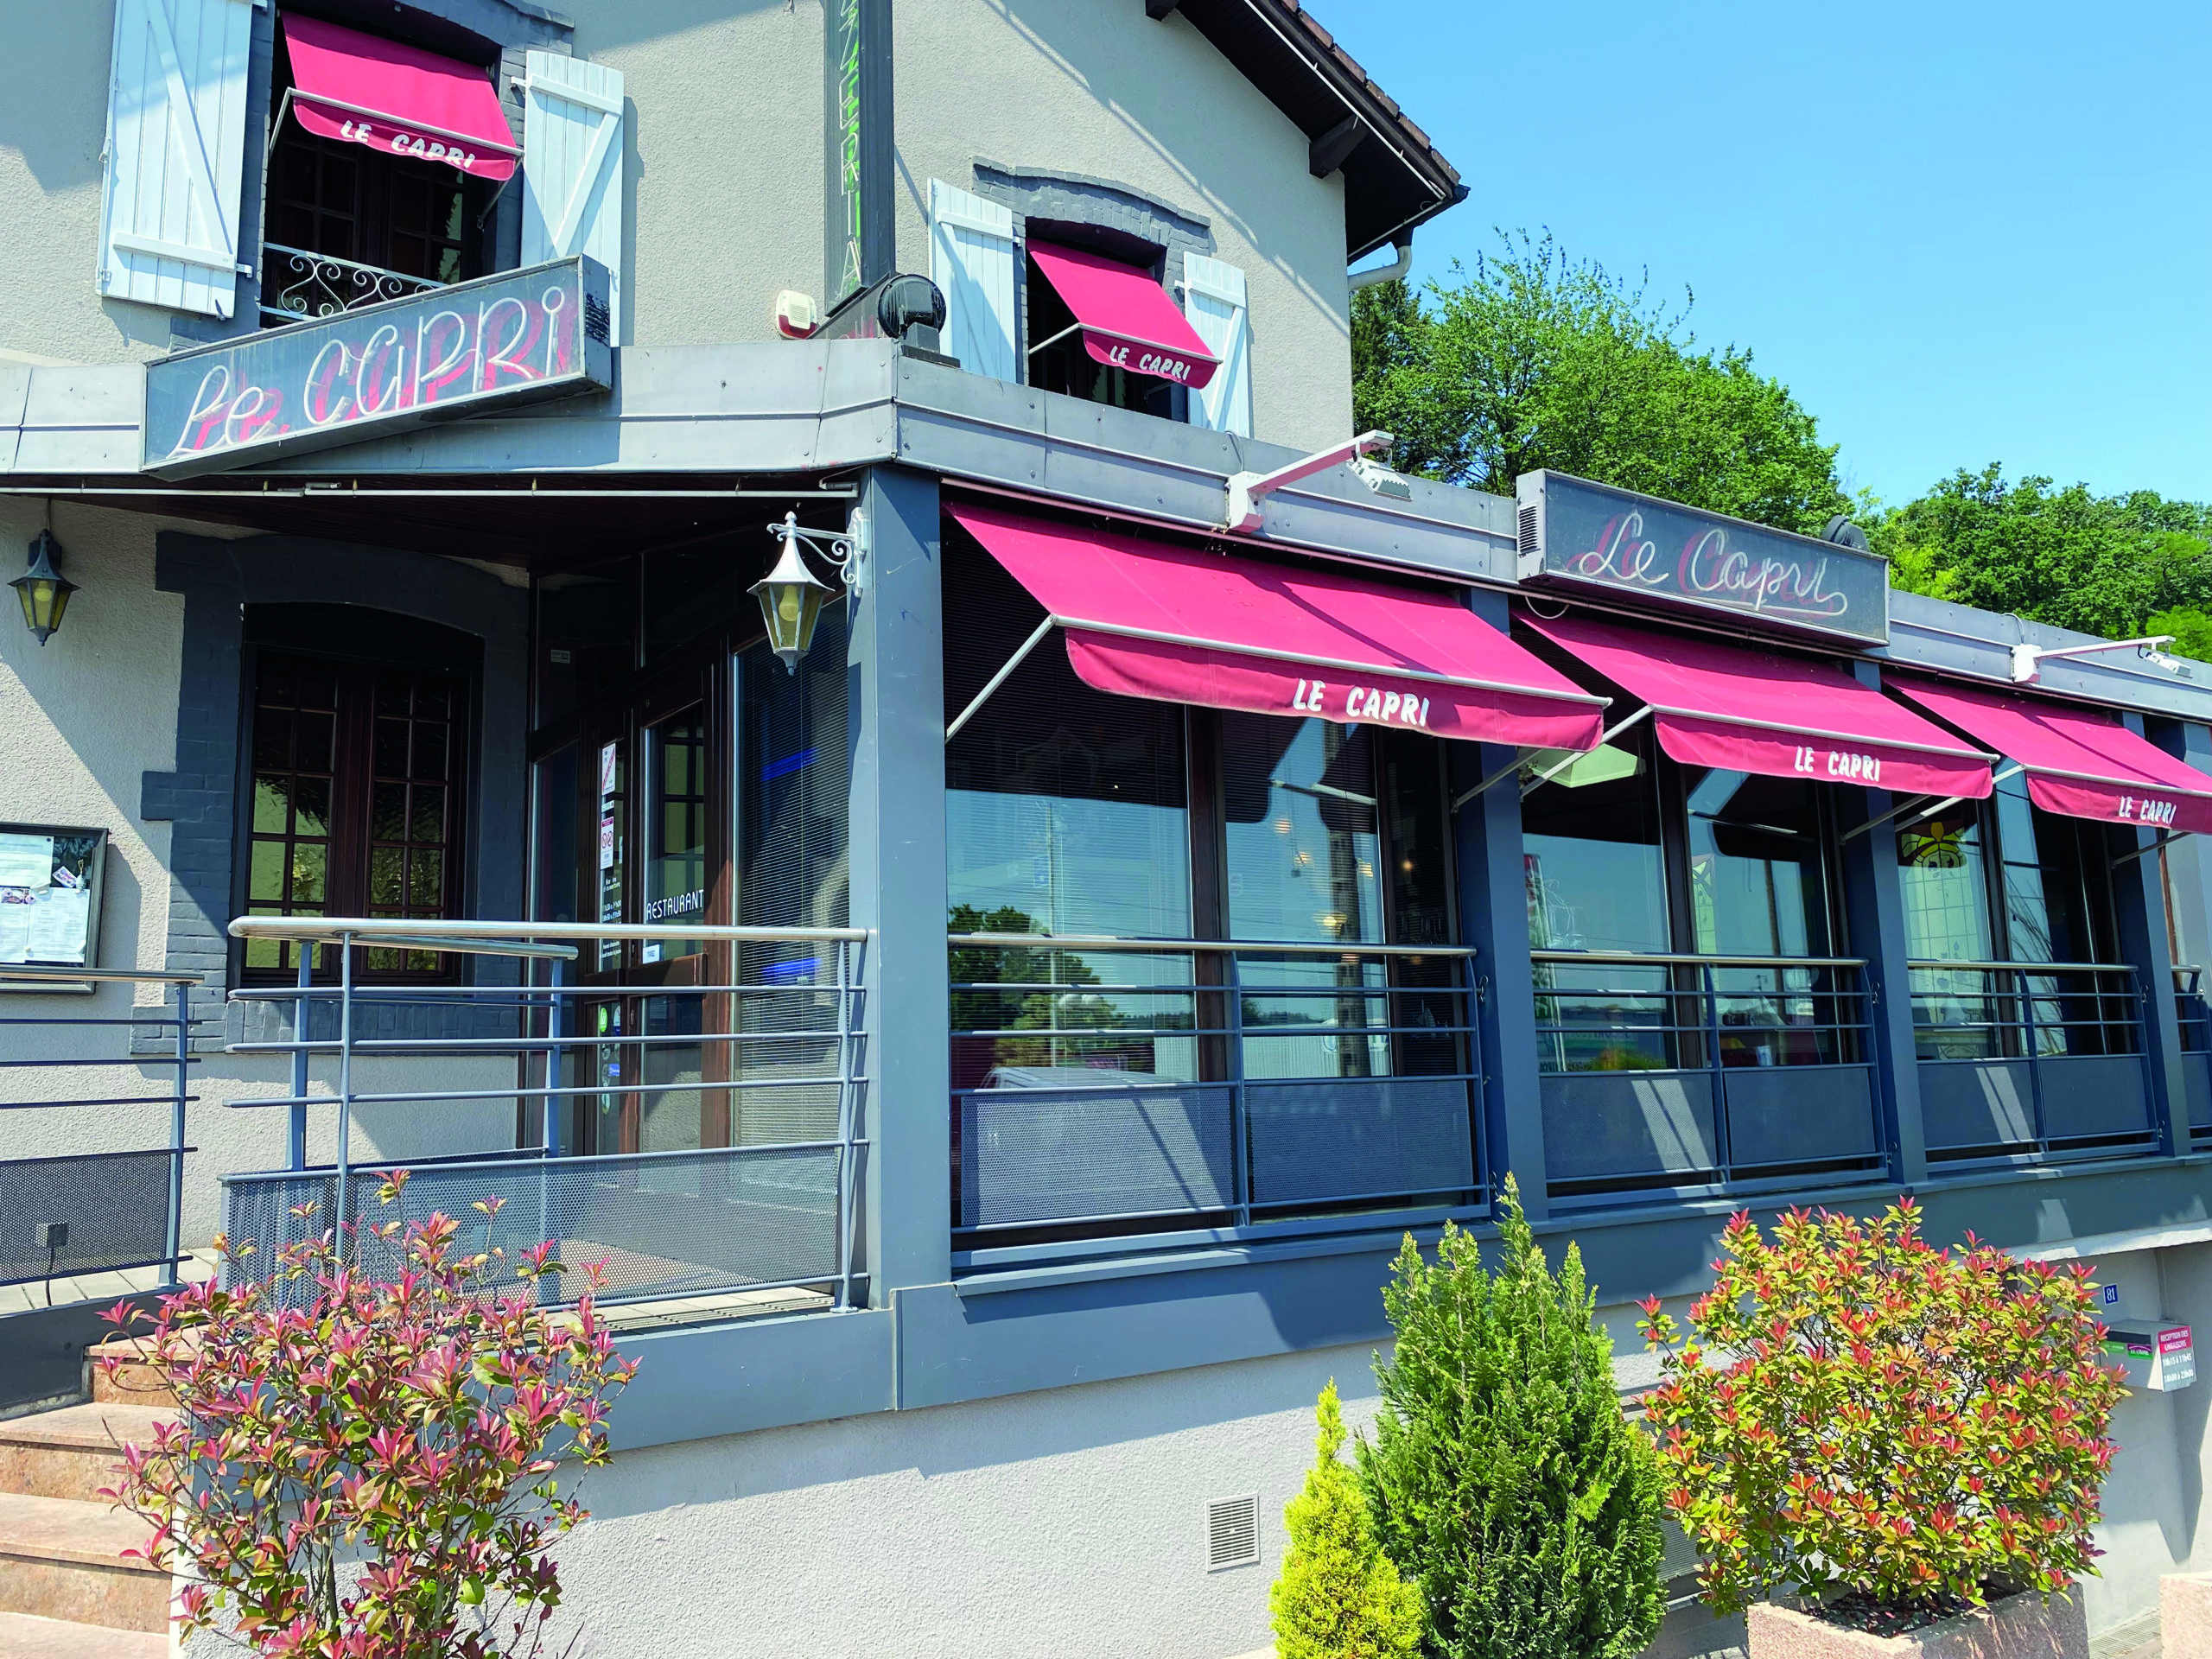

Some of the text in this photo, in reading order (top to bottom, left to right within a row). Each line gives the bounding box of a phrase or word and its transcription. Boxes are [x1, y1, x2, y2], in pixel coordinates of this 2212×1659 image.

[340, 120, 475, 168] LE CAPRI
[1109, 346, 1192, 381] LE CAPRI
[1579, 512, 1848, 616] Le Capri
[1293, 678, 1430, 727] LE CAPRI
[1795, 747, 1880, 782] LE CAPRI
[2119, 796, 2177, 824] LE CAPRI
[647, 889, 704, 920] RESTAURANT
[2107, 1287, 2116, 1301] 81
